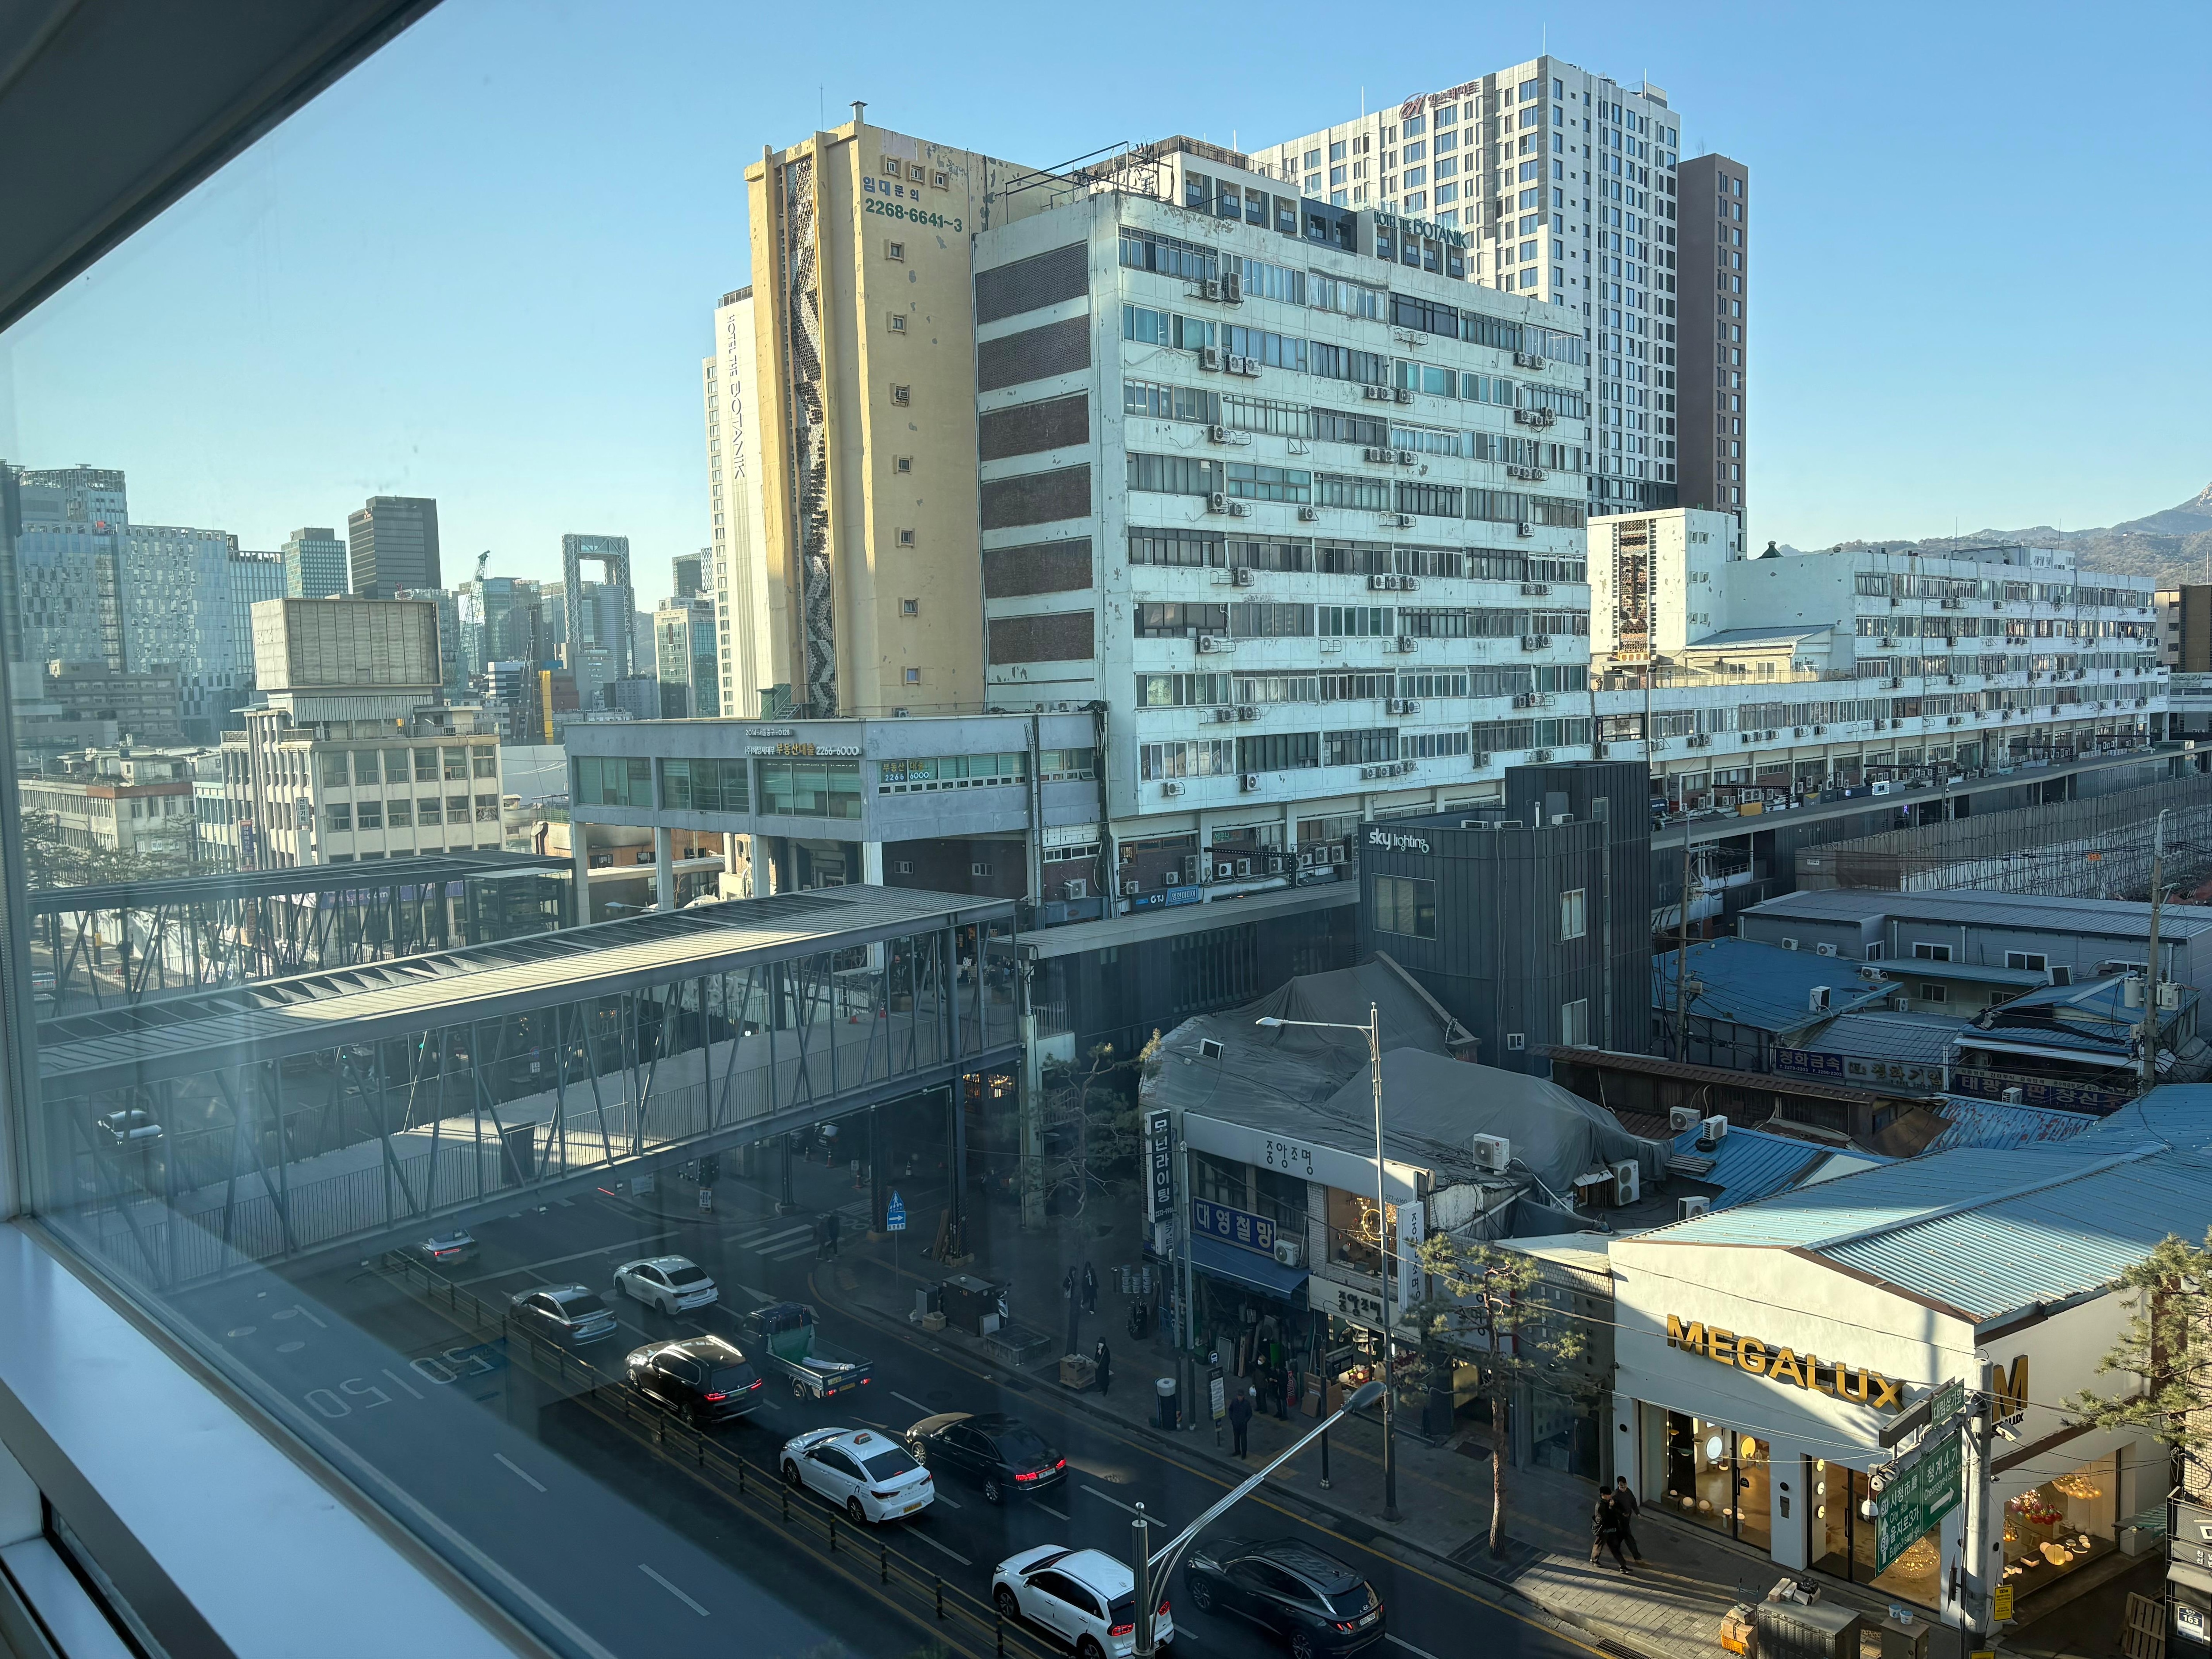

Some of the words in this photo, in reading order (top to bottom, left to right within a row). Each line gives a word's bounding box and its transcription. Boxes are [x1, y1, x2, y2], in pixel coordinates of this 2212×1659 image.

[865, 198, 962, 232] 2268-6641~3
[1374, 211, 1398, 229] HOTEL
[1399, 218, 1412, 233] THE
[1414, 218, 1468, 249] BOTANIK
[730, 380, 745, 479] BOTANIK
[816, 746, 860, 756] 2266-6000
[883, 762, 905, 772] 부동산
[1369, 828, 1391, 850] sky
[1394, 834, 1429, 853] lighting
[1780, 1050, 1839, 1071] 청화금속
[1267, 1140, 1313, 1175] 중앙조명
[1196, 1203, 1272, 1248] 대영철망
[1338, 1290, 1383, 1324] 중앙조명
[1667, 1314, 1906, 1412] MEGALUX
[1933, 1386, 1962, 1420] 대림상가앞
[1882, 1502, 1888, 1513] 31
[1890, 1505, 1919, 1544] 을지로3가
[1882, 1536, 1888, 1551] 60
[2183, 1615, 2199, 1625] 163
